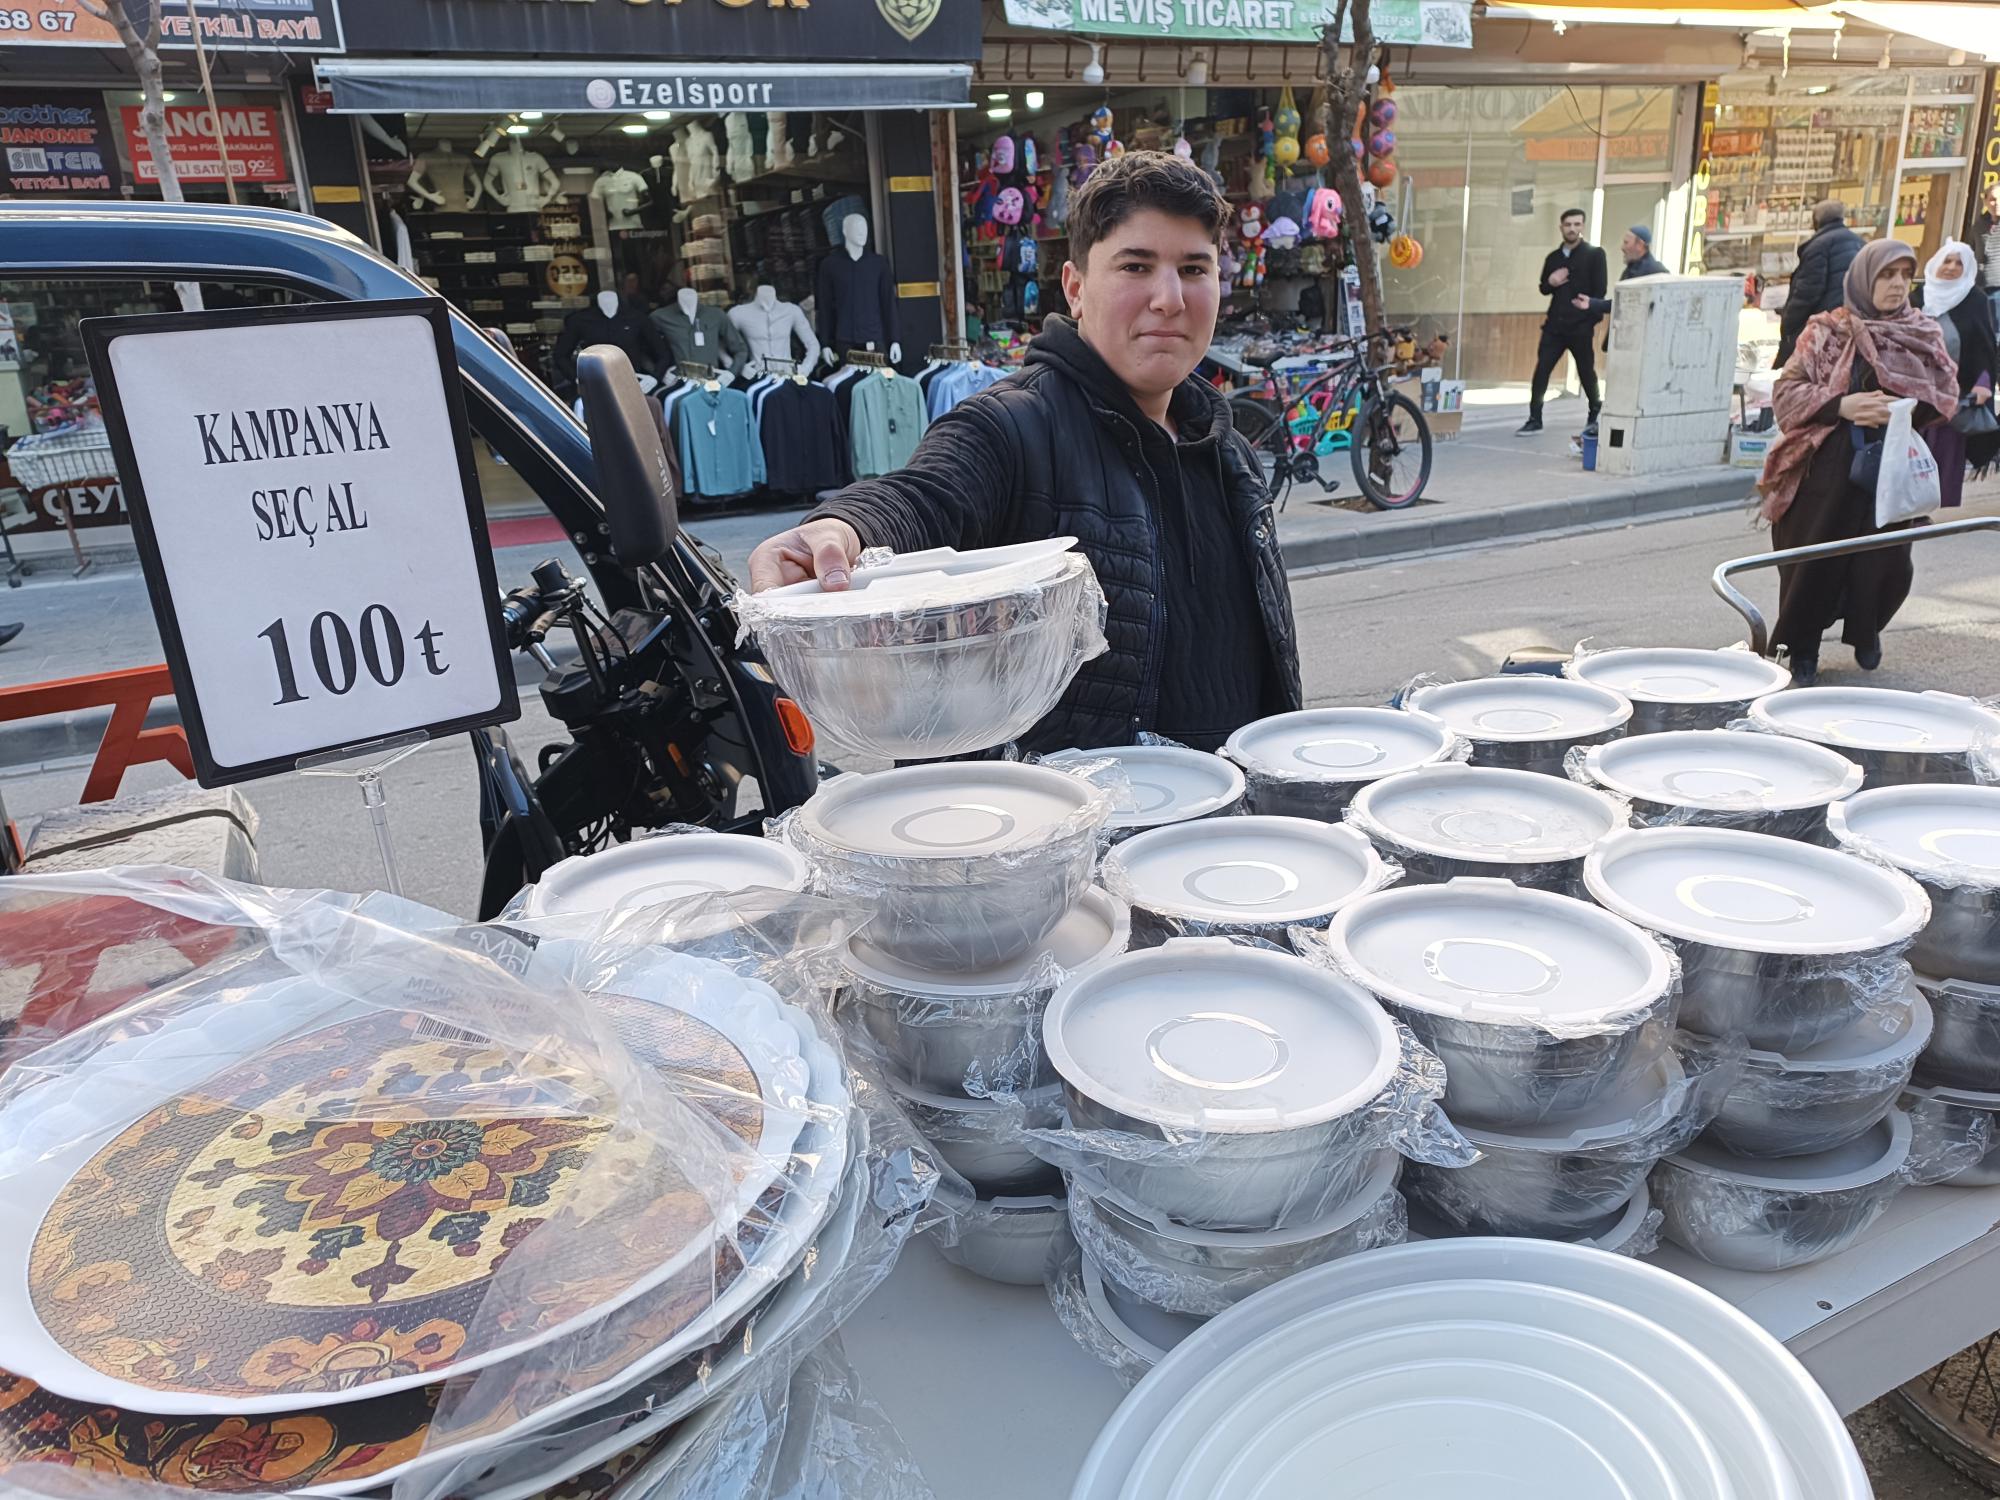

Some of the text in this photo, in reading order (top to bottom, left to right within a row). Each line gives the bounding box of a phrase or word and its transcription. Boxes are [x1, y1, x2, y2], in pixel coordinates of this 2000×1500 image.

[39, 10, 76, 32] 67
[617, 77, 773, 108] Ezelsporr
[0, 127, 95, 144] JANOME
[140, 162, 190, 176] YEİLİ
[193, 400, 390, 465] KAMPANYA
